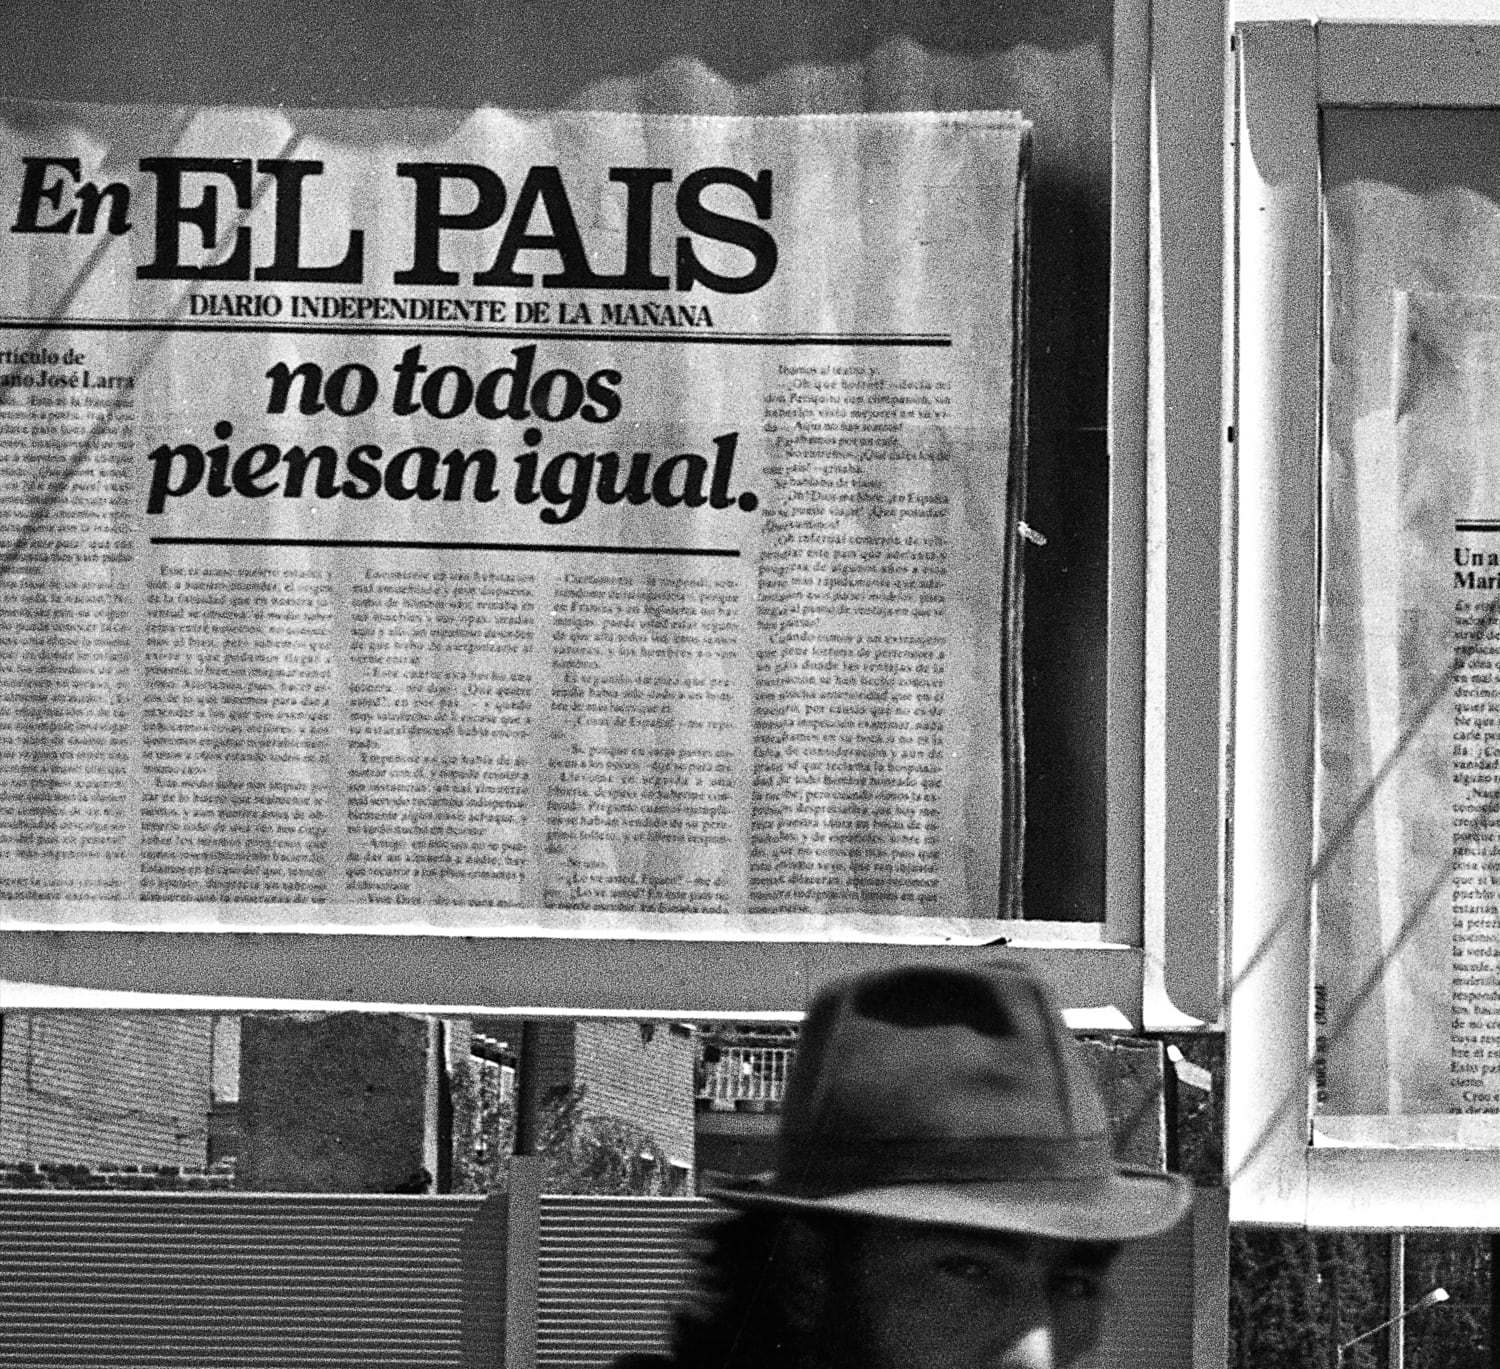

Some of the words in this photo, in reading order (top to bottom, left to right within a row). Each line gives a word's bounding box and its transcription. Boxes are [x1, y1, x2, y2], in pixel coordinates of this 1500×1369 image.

[11, 155, 133, 237] En
[135, 156, 365, 285] EL
[393, 161, 779, 295] PAIS
[190, 294, 283, 318] DIARIO
[289, 297, 506, 324] INDEPENDIENTE
[515, 302, 550, 325] DE
[558, 304, 593, 326] LA
[600, 301, 715, 328] MAÑANA
[63, 348, 85, 366] de
[82, 370, 135, 389] Larra
[266, 361, 380, 419] no
[392, 344, 623, 424] todos
[146, 421, 499, 516] piensan
[514, 428, 763, 526] igual.
[1453, 548, 1483, 567] Un
